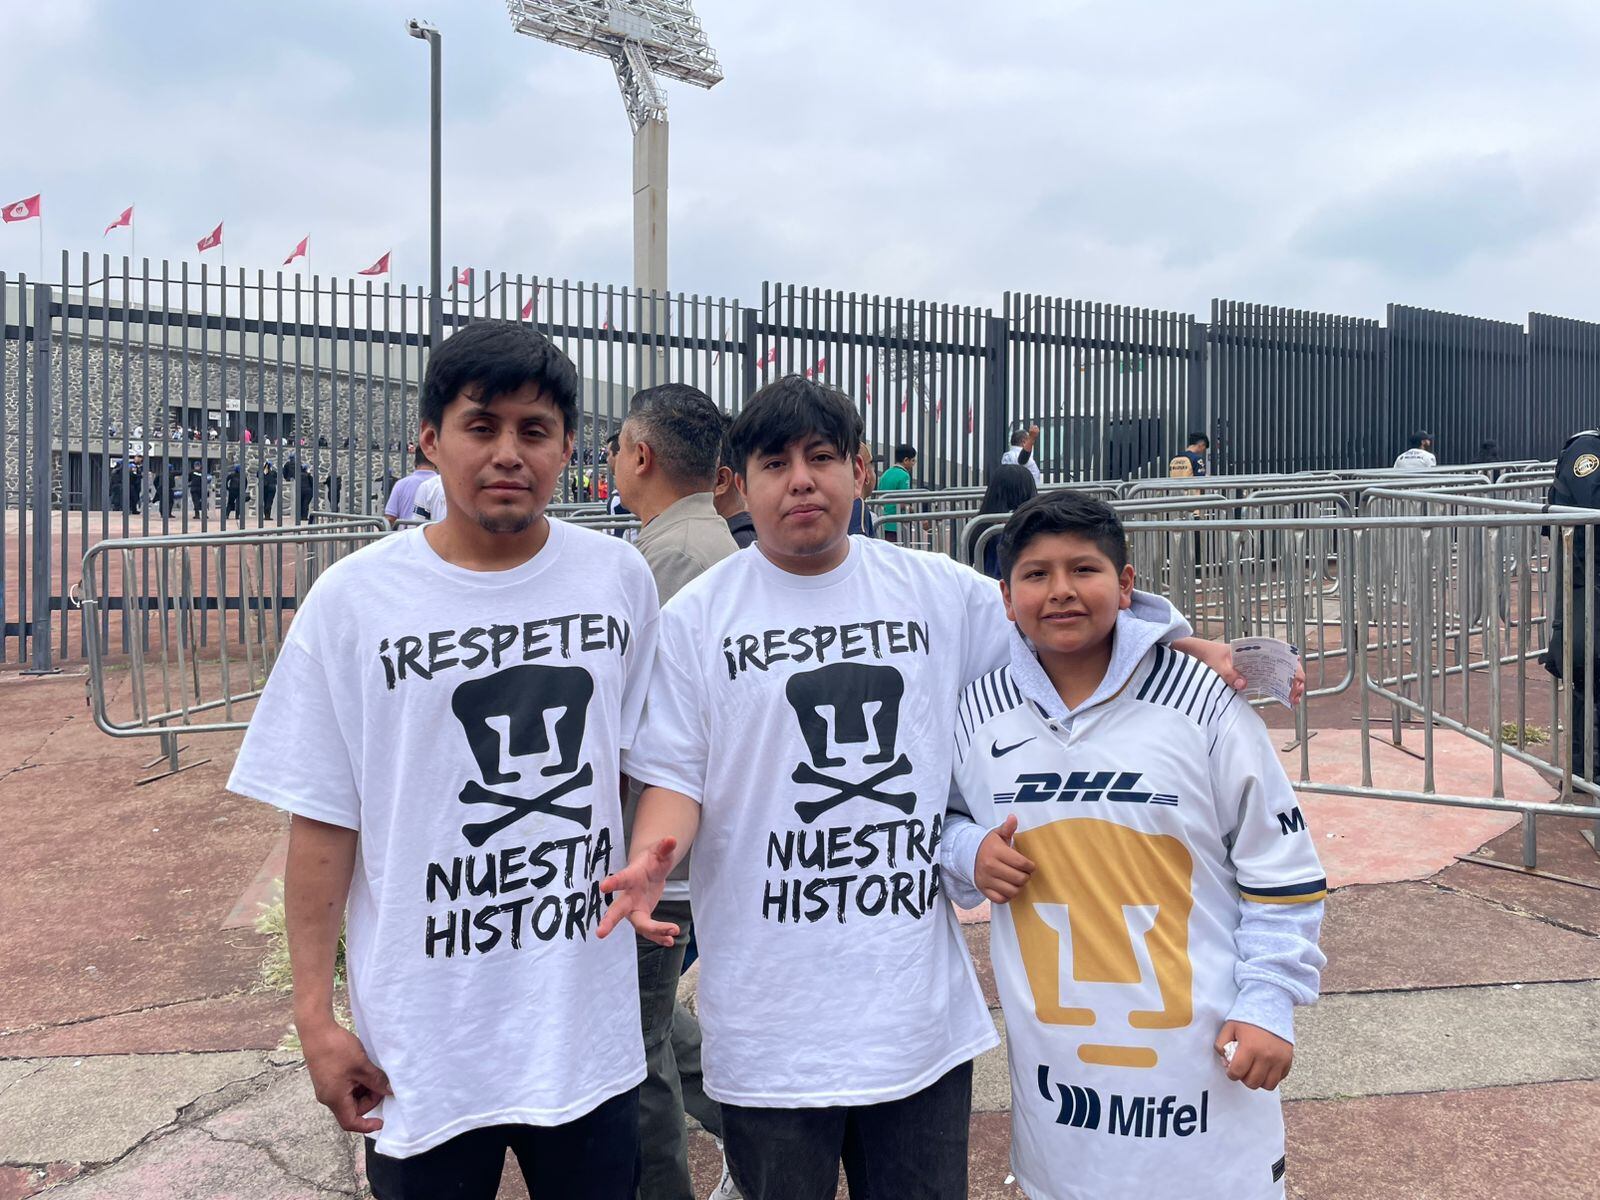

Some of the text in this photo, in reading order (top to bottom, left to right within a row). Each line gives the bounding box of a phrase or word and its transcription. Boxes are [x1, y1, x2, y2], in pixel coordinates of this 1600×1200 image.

[379, 614, 630, 690] ¡RESPETEN
[723, 620, 929, 680] ¡RESPETEN
[1013, 771, 1152, 803] DHL
[1276, 806, 1308, 836] M
[1108, 1090, 1208, 1138] Mifel
